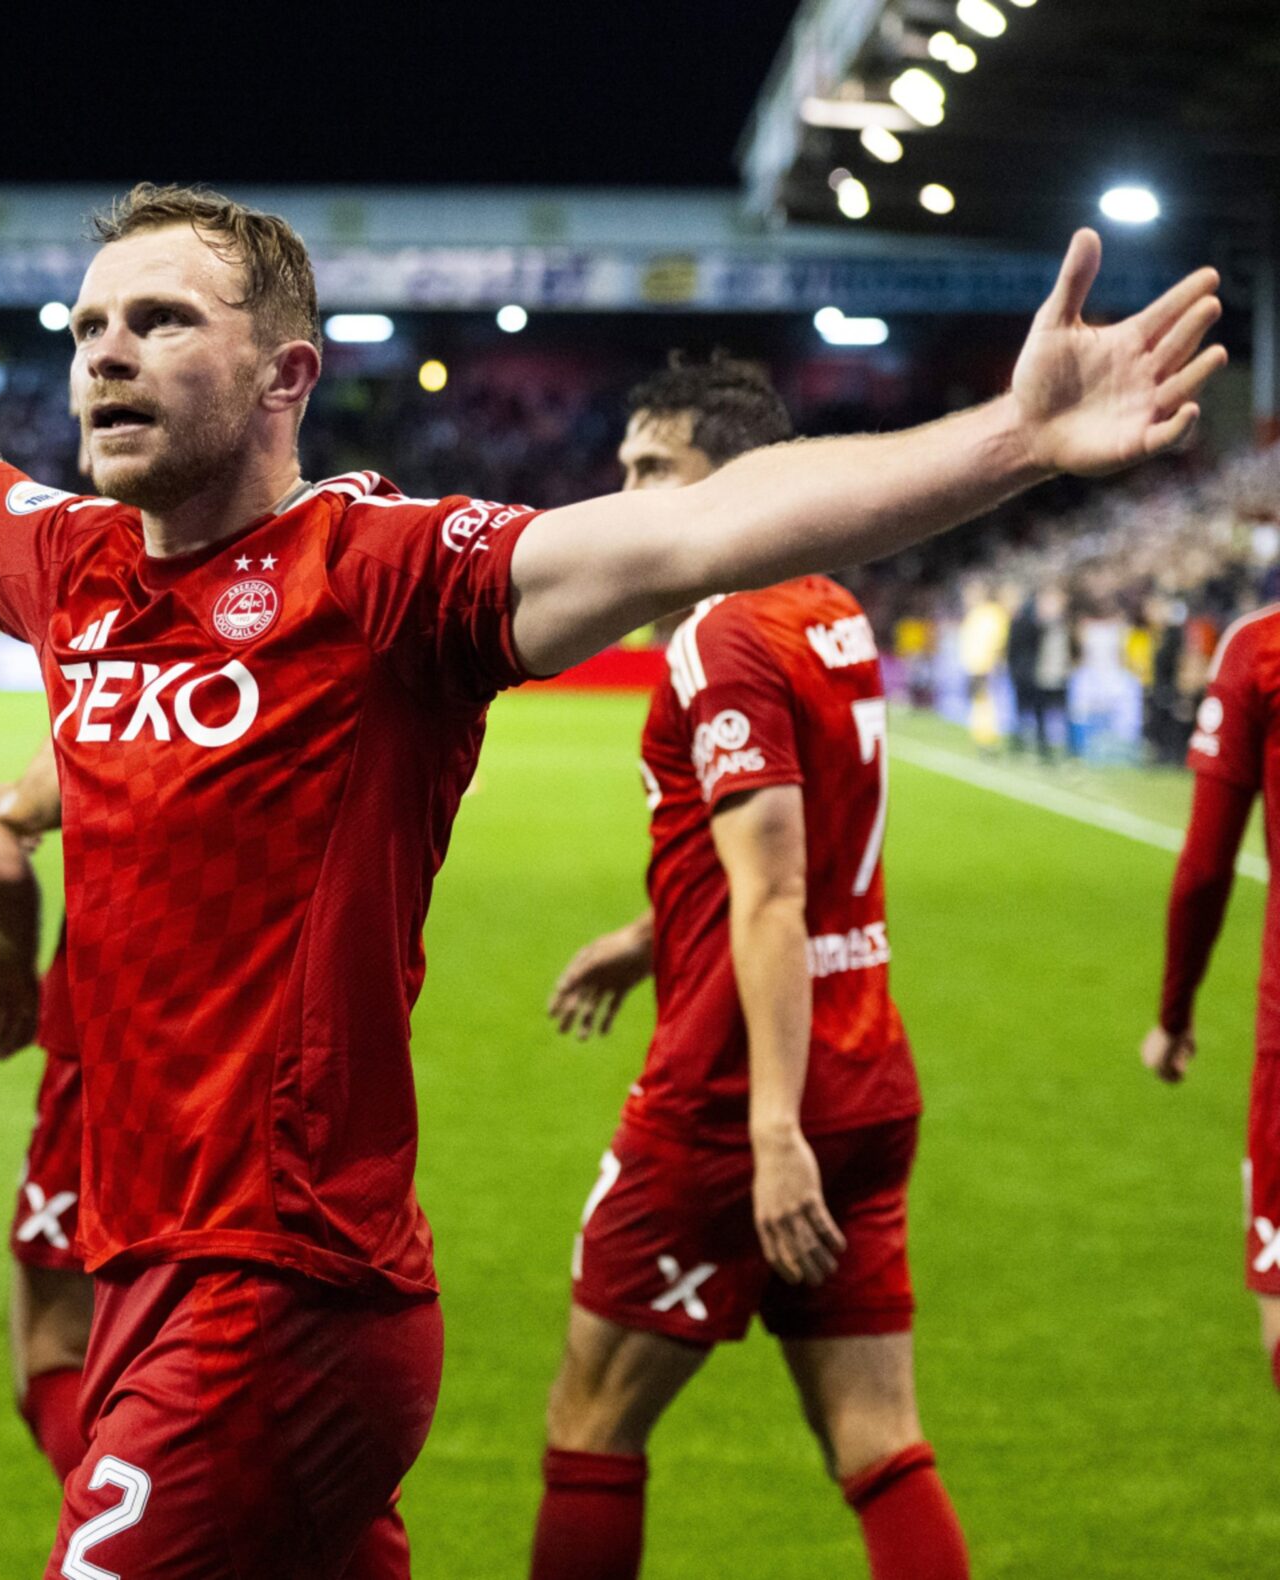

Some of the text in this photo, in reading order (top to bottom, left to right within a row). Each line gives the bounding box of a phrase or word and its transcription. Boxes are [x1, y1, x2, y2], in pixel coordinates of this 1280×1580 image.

[217, 610, 273, 638] FOOTBALL CLUB
[229, 582, 271, 599] ABERDEEN
[53, 658, 260, 748] TEXO
[851, 697, 887, 896] 7
[61, 1454, 152, 1580] 2
